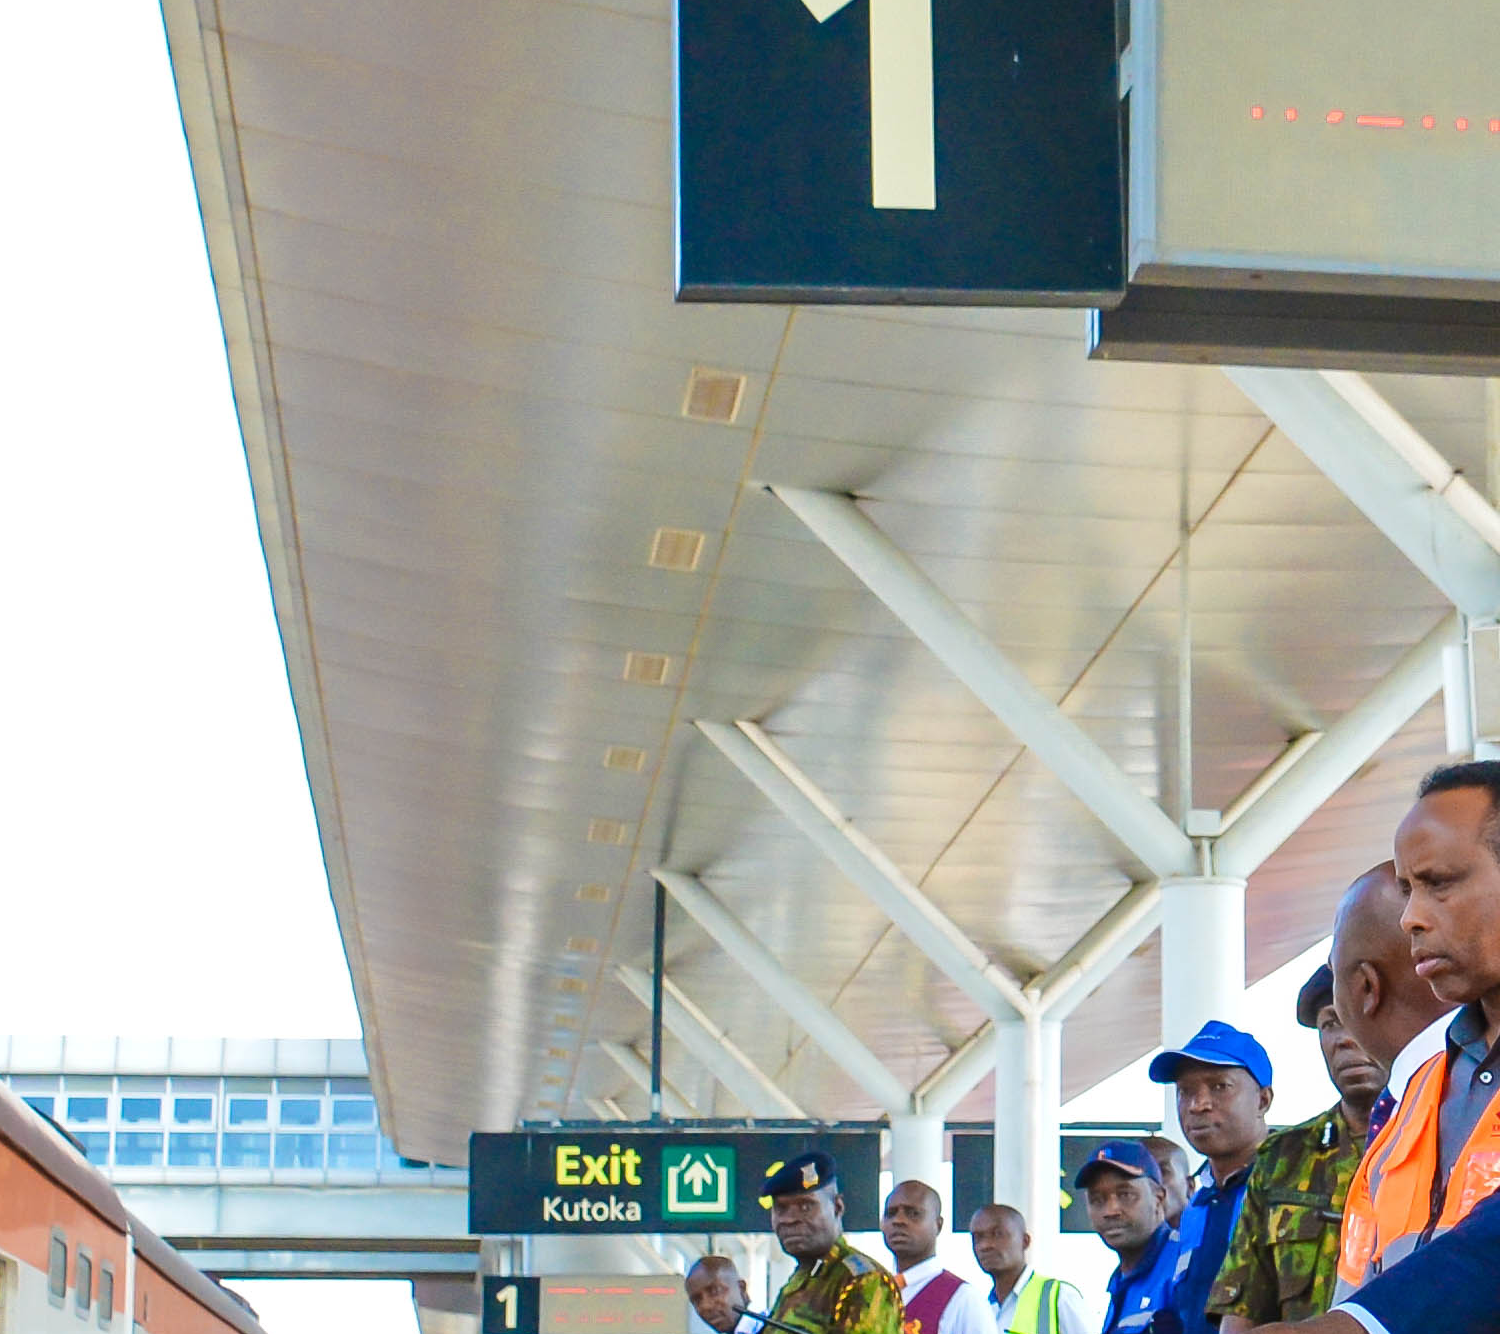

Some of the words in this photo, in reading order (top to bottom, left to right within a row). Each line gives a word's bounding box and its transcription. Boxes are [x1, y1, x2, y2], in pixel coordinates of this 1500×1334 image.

[556, 1143, 642, 1186] Exit
[543, 1194, 642, 1222] Kutoka
[496, 1284, 519, 1329] 1
